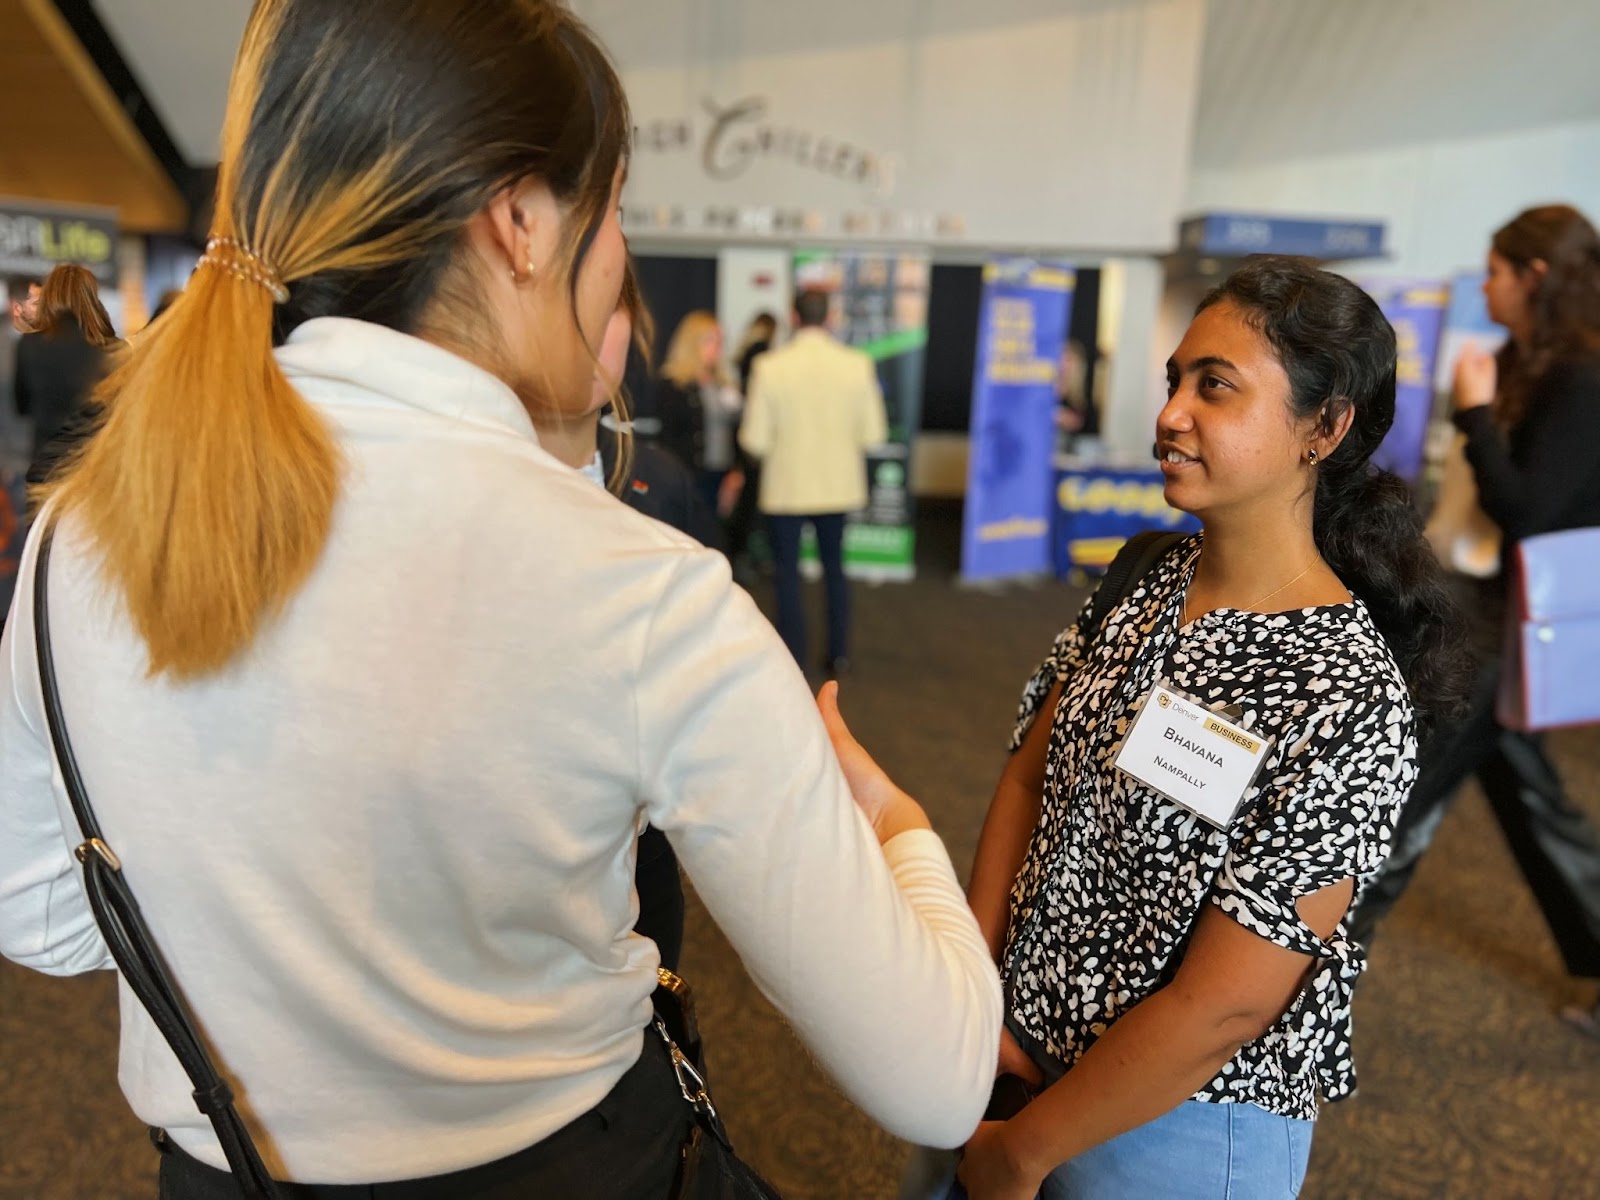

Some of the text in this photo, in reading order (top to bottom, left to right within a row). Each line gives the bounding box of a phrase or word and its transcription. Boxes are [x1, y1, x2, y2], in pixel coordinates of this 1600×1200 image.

[1172, 702, 1253, 750] Denver BUSINESS
[1163, 727, 1224, 768] BHAVANA
[1153, 755, 1207, 790] NAMPALLY
